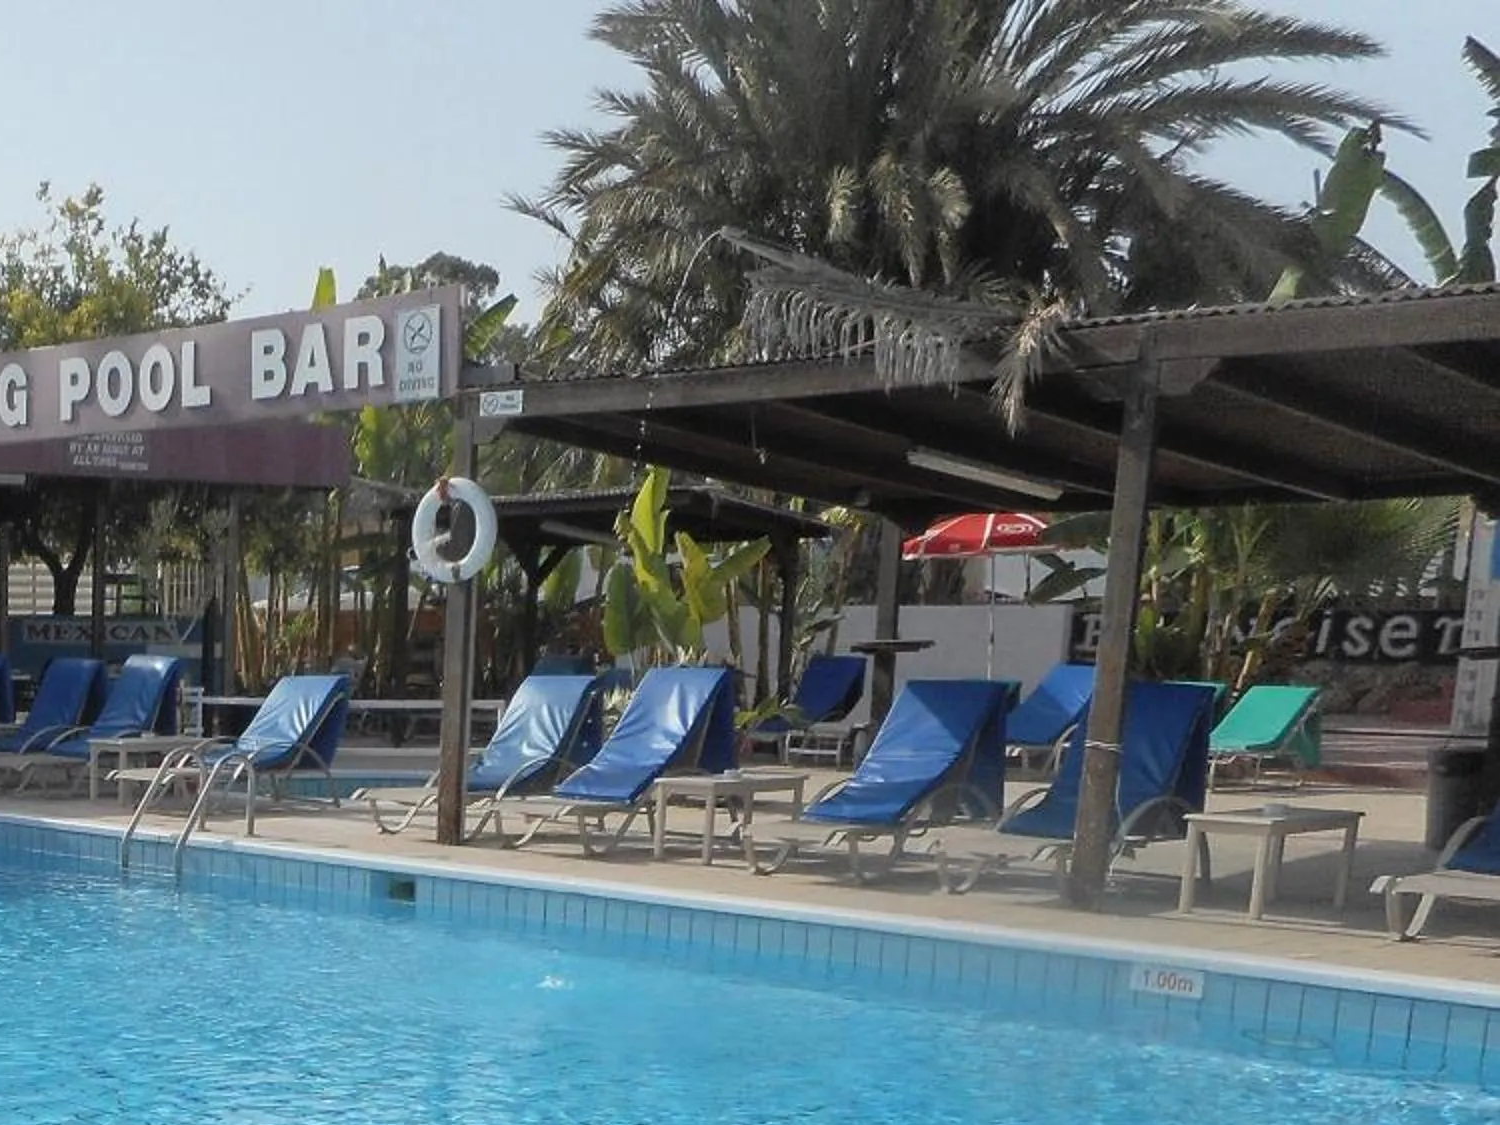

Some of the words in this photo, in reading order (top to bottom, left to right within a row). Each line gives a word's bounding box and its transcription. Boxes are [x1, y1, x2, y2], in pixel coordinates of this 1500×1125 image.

[60, 341, 211, 421] POOL
[252, 316, 385, 399] BAR
[27, 624, 176, 641] MEXCAN
[1143, 969, 1194, 993] 1.00m
